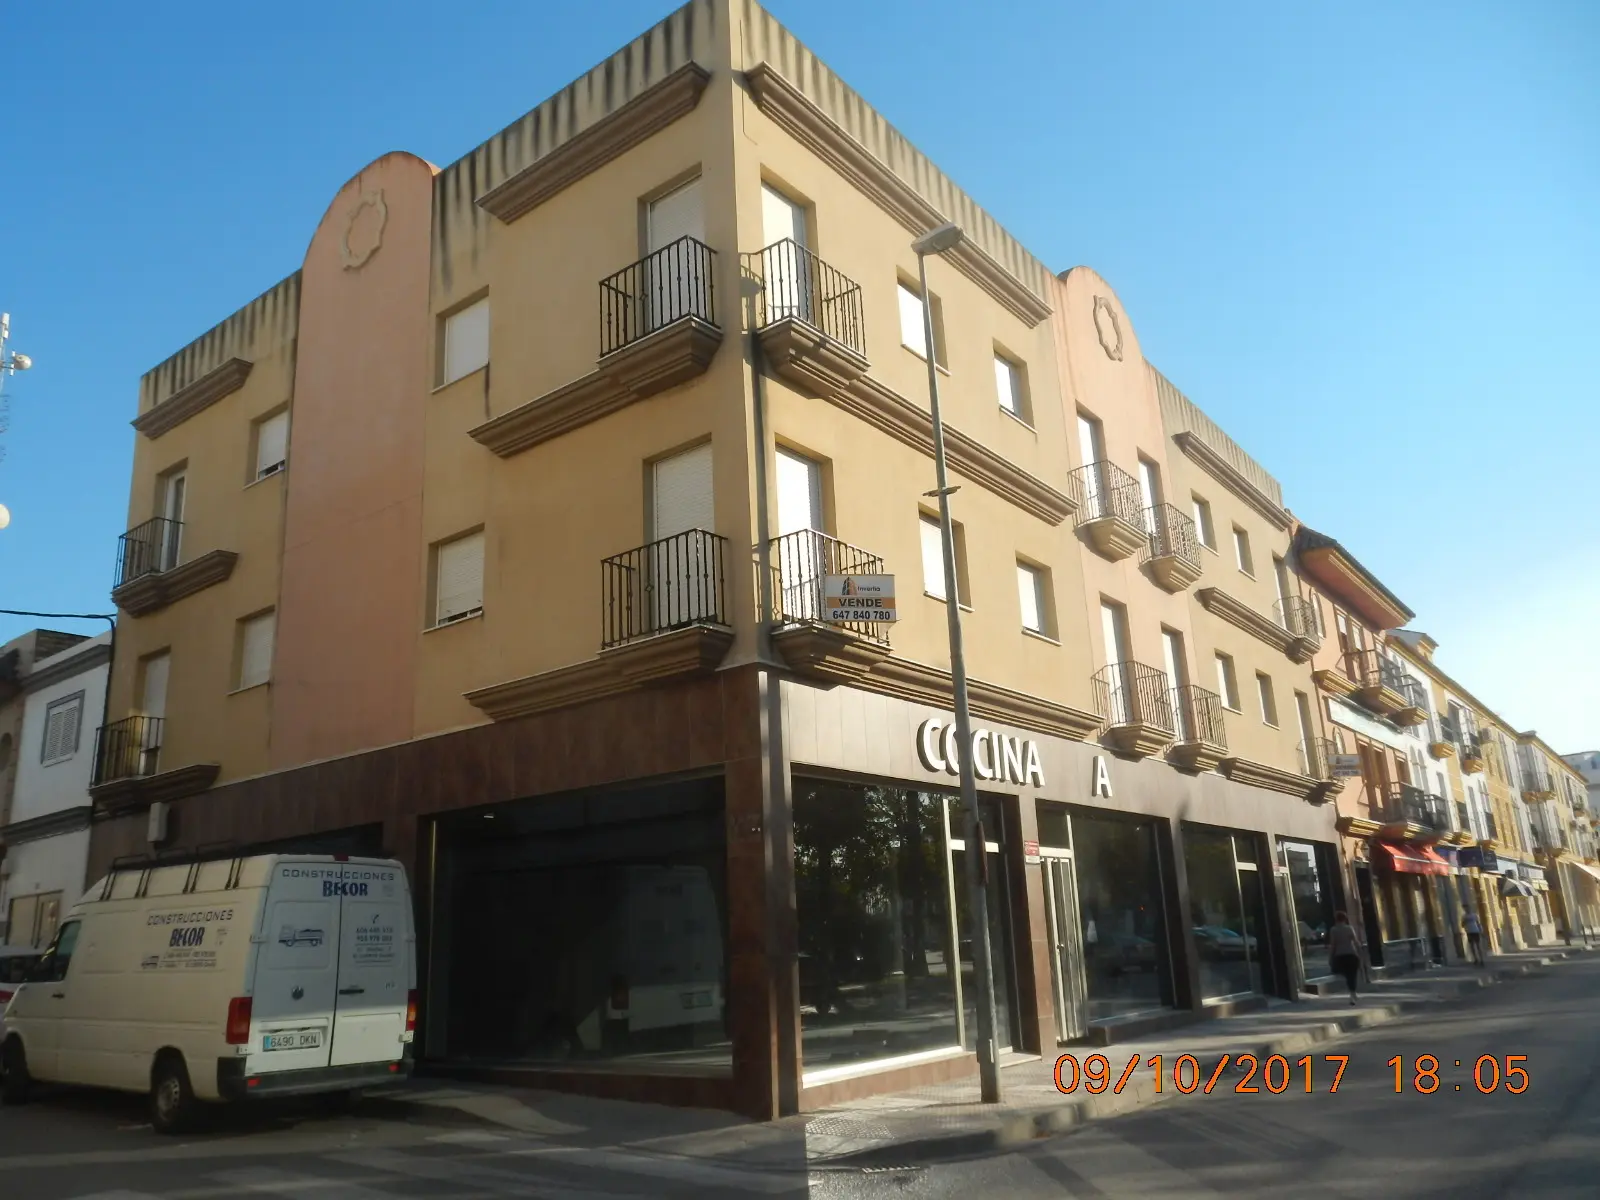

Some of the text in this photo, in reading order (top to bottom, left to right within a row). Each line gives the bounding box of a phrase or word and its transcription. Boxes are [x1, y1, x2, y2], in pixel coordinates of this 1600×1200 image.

[838, 598, 883, 608] VENDE
[832, 610, 891, 620] 647 840 780
[1092, 755, 1113, 798] A
[282, 869, 395, 881] CONSTRUCCIONES
[146, 909, 234, 926] CONSTRUCCIONES
[169, 927, 205, 947] BECOR
[271, 1034, 317, 1048] 6490 DKN
